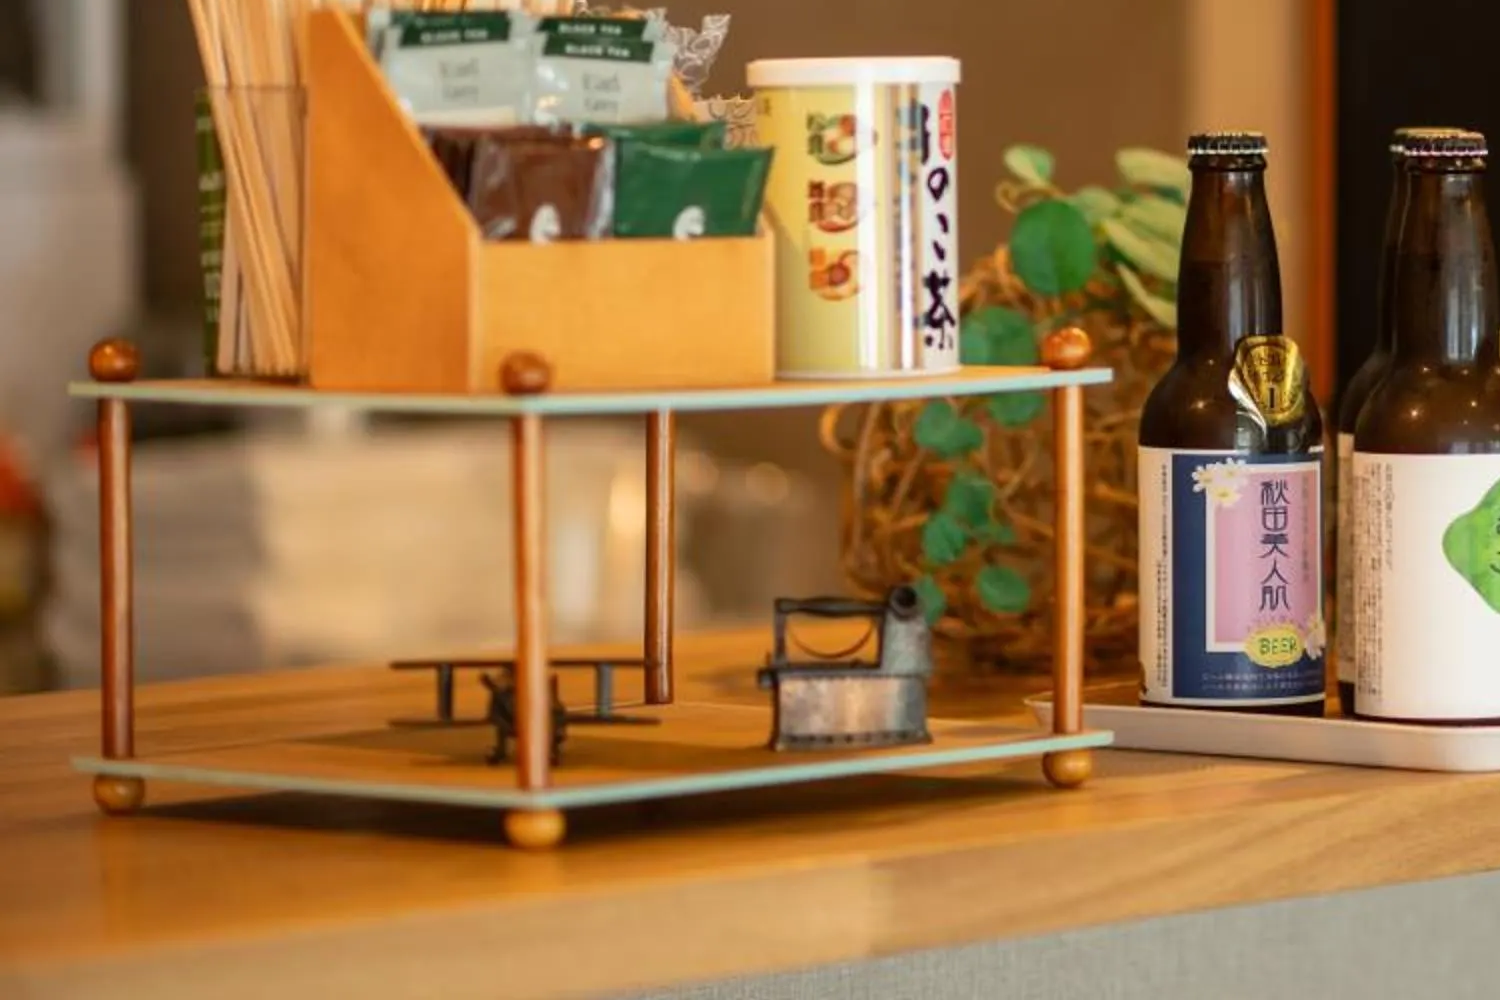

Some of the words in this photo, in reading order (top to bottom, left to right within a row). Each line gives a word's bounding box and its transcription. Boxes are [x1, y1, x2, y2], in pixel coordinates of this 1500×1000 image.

[1259, 480, 1292, 612] 秋田美人肌
[1258, 636, 1298, 656] BEER
